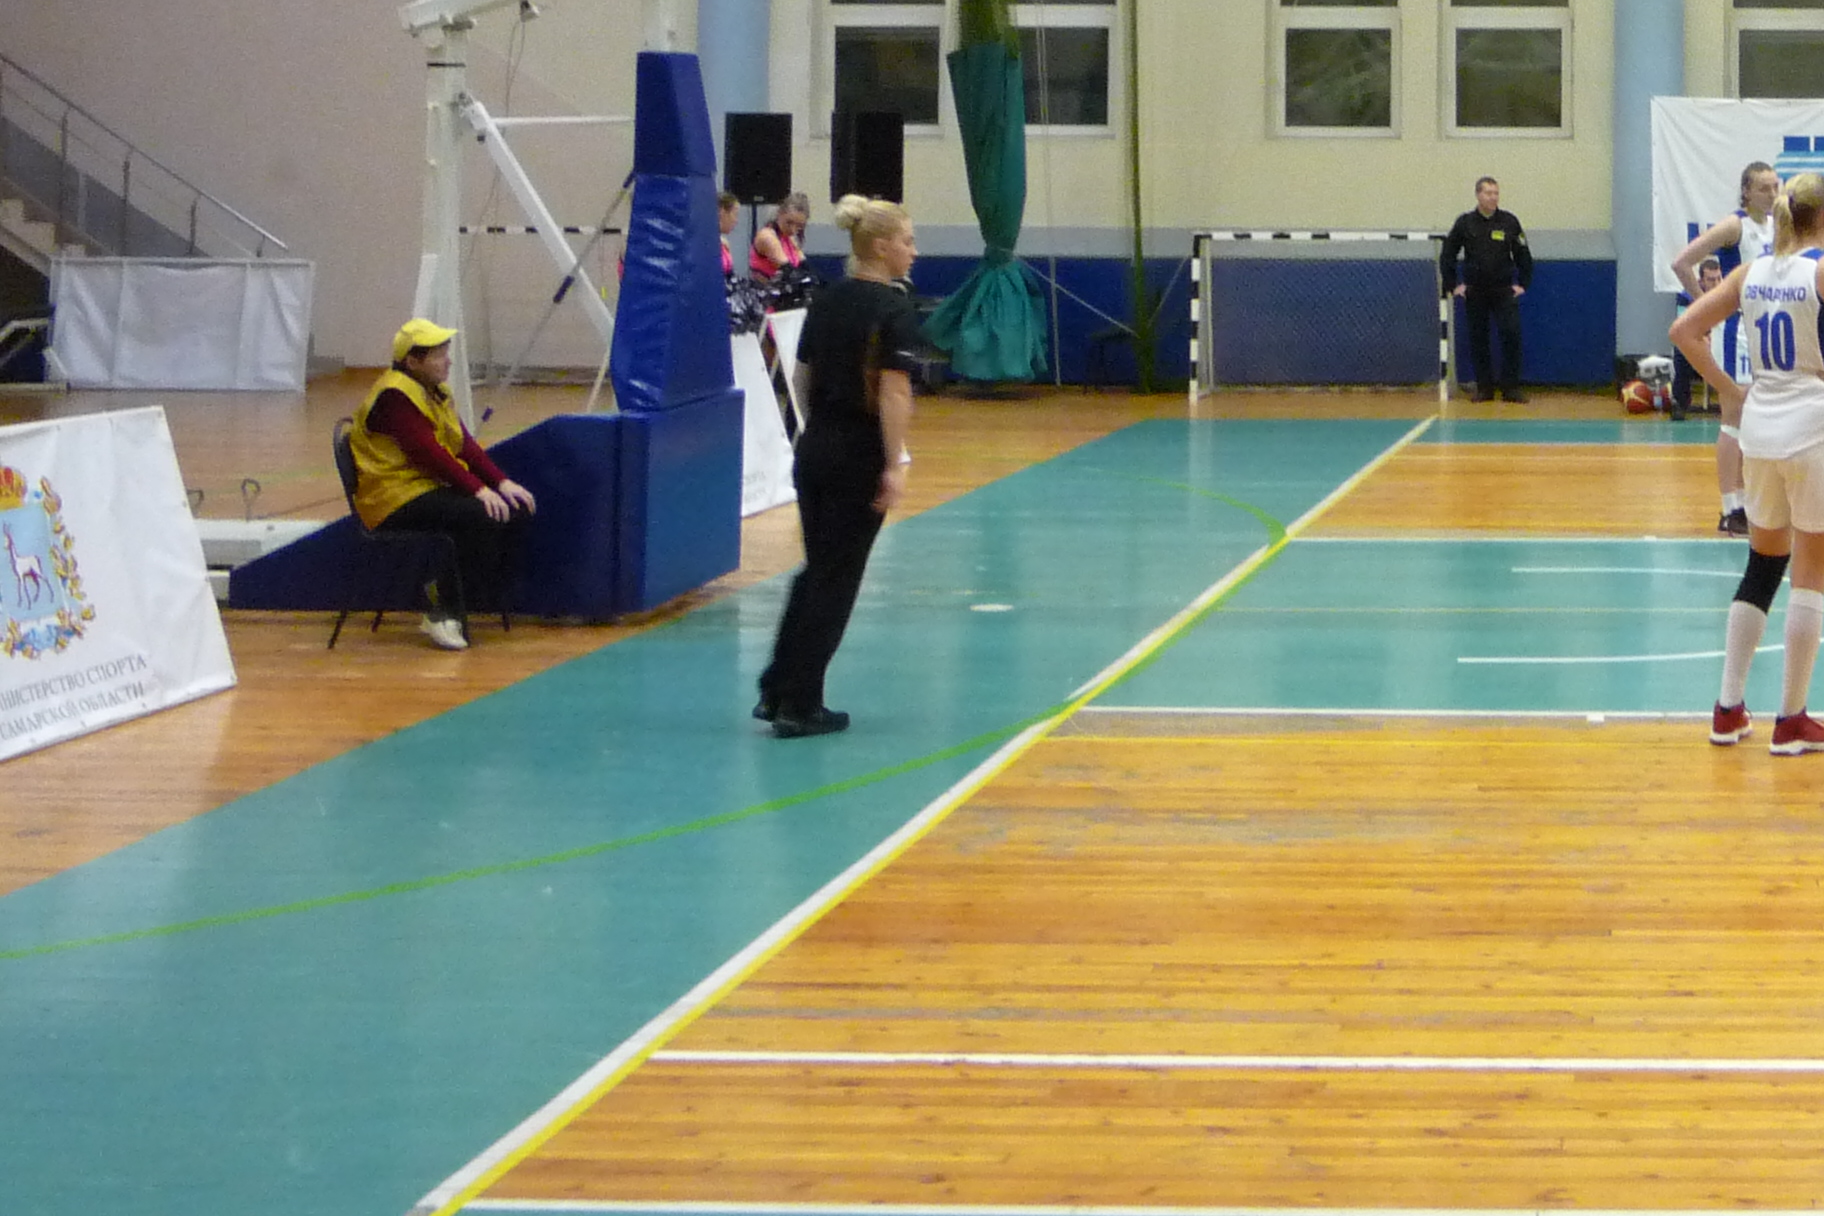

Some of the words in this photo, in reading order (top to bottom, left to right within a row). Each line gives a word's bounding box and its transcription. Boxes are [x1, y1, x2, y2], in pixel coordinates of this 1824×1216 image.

[1754, 310, 1796, 372] 10
[0, 672, 85, 711] НИСТЕРСТВО
[86, 654, 147, 685] СПОРТА
[0, 700, 77, 740] САМАРСКОЙ
[78, 681, 145, 712] ОБЛАСТИ
